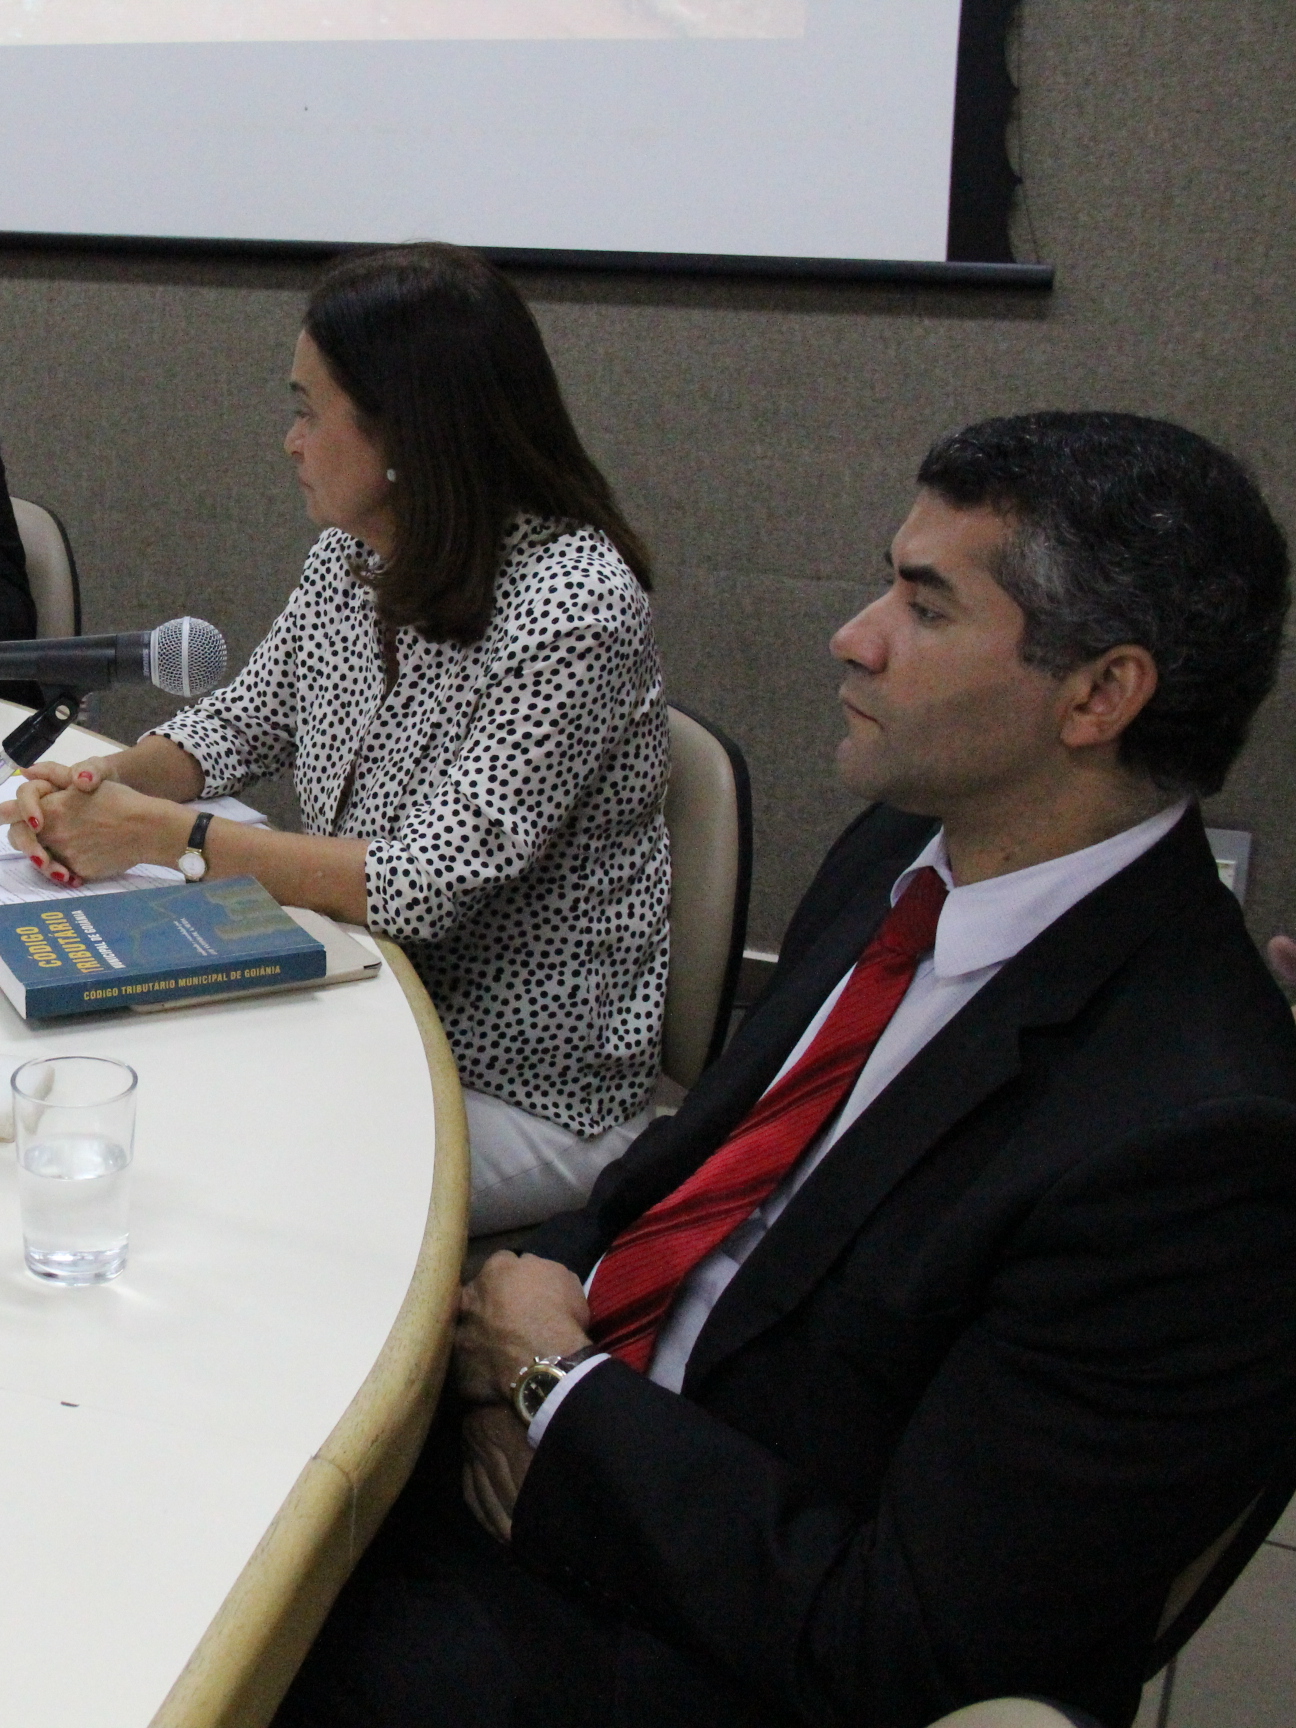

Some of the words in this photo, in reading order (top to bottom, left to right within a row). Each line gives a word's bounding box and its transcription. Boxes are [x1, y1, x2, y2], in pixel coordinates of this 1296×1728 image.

[71, 910, 96, 934] GOIÂNIA
[87, 933, 103, 942] DE
[15, 926, 62, 968] CÓDIGO
[40, 911, 104, 973] TRIBUTÁRIO
[94, 942, 126, 969] MUNICIPAL
[83, 987, 119, 1000] CÓDIGO
[121, 979, 175, 995] TRIBUTÁRIO
[178, 972, 228, 987] MUNICIPAL
[230, 970, 242, 979] DE
[244, 964, 281, 978] GOIÂNIA
